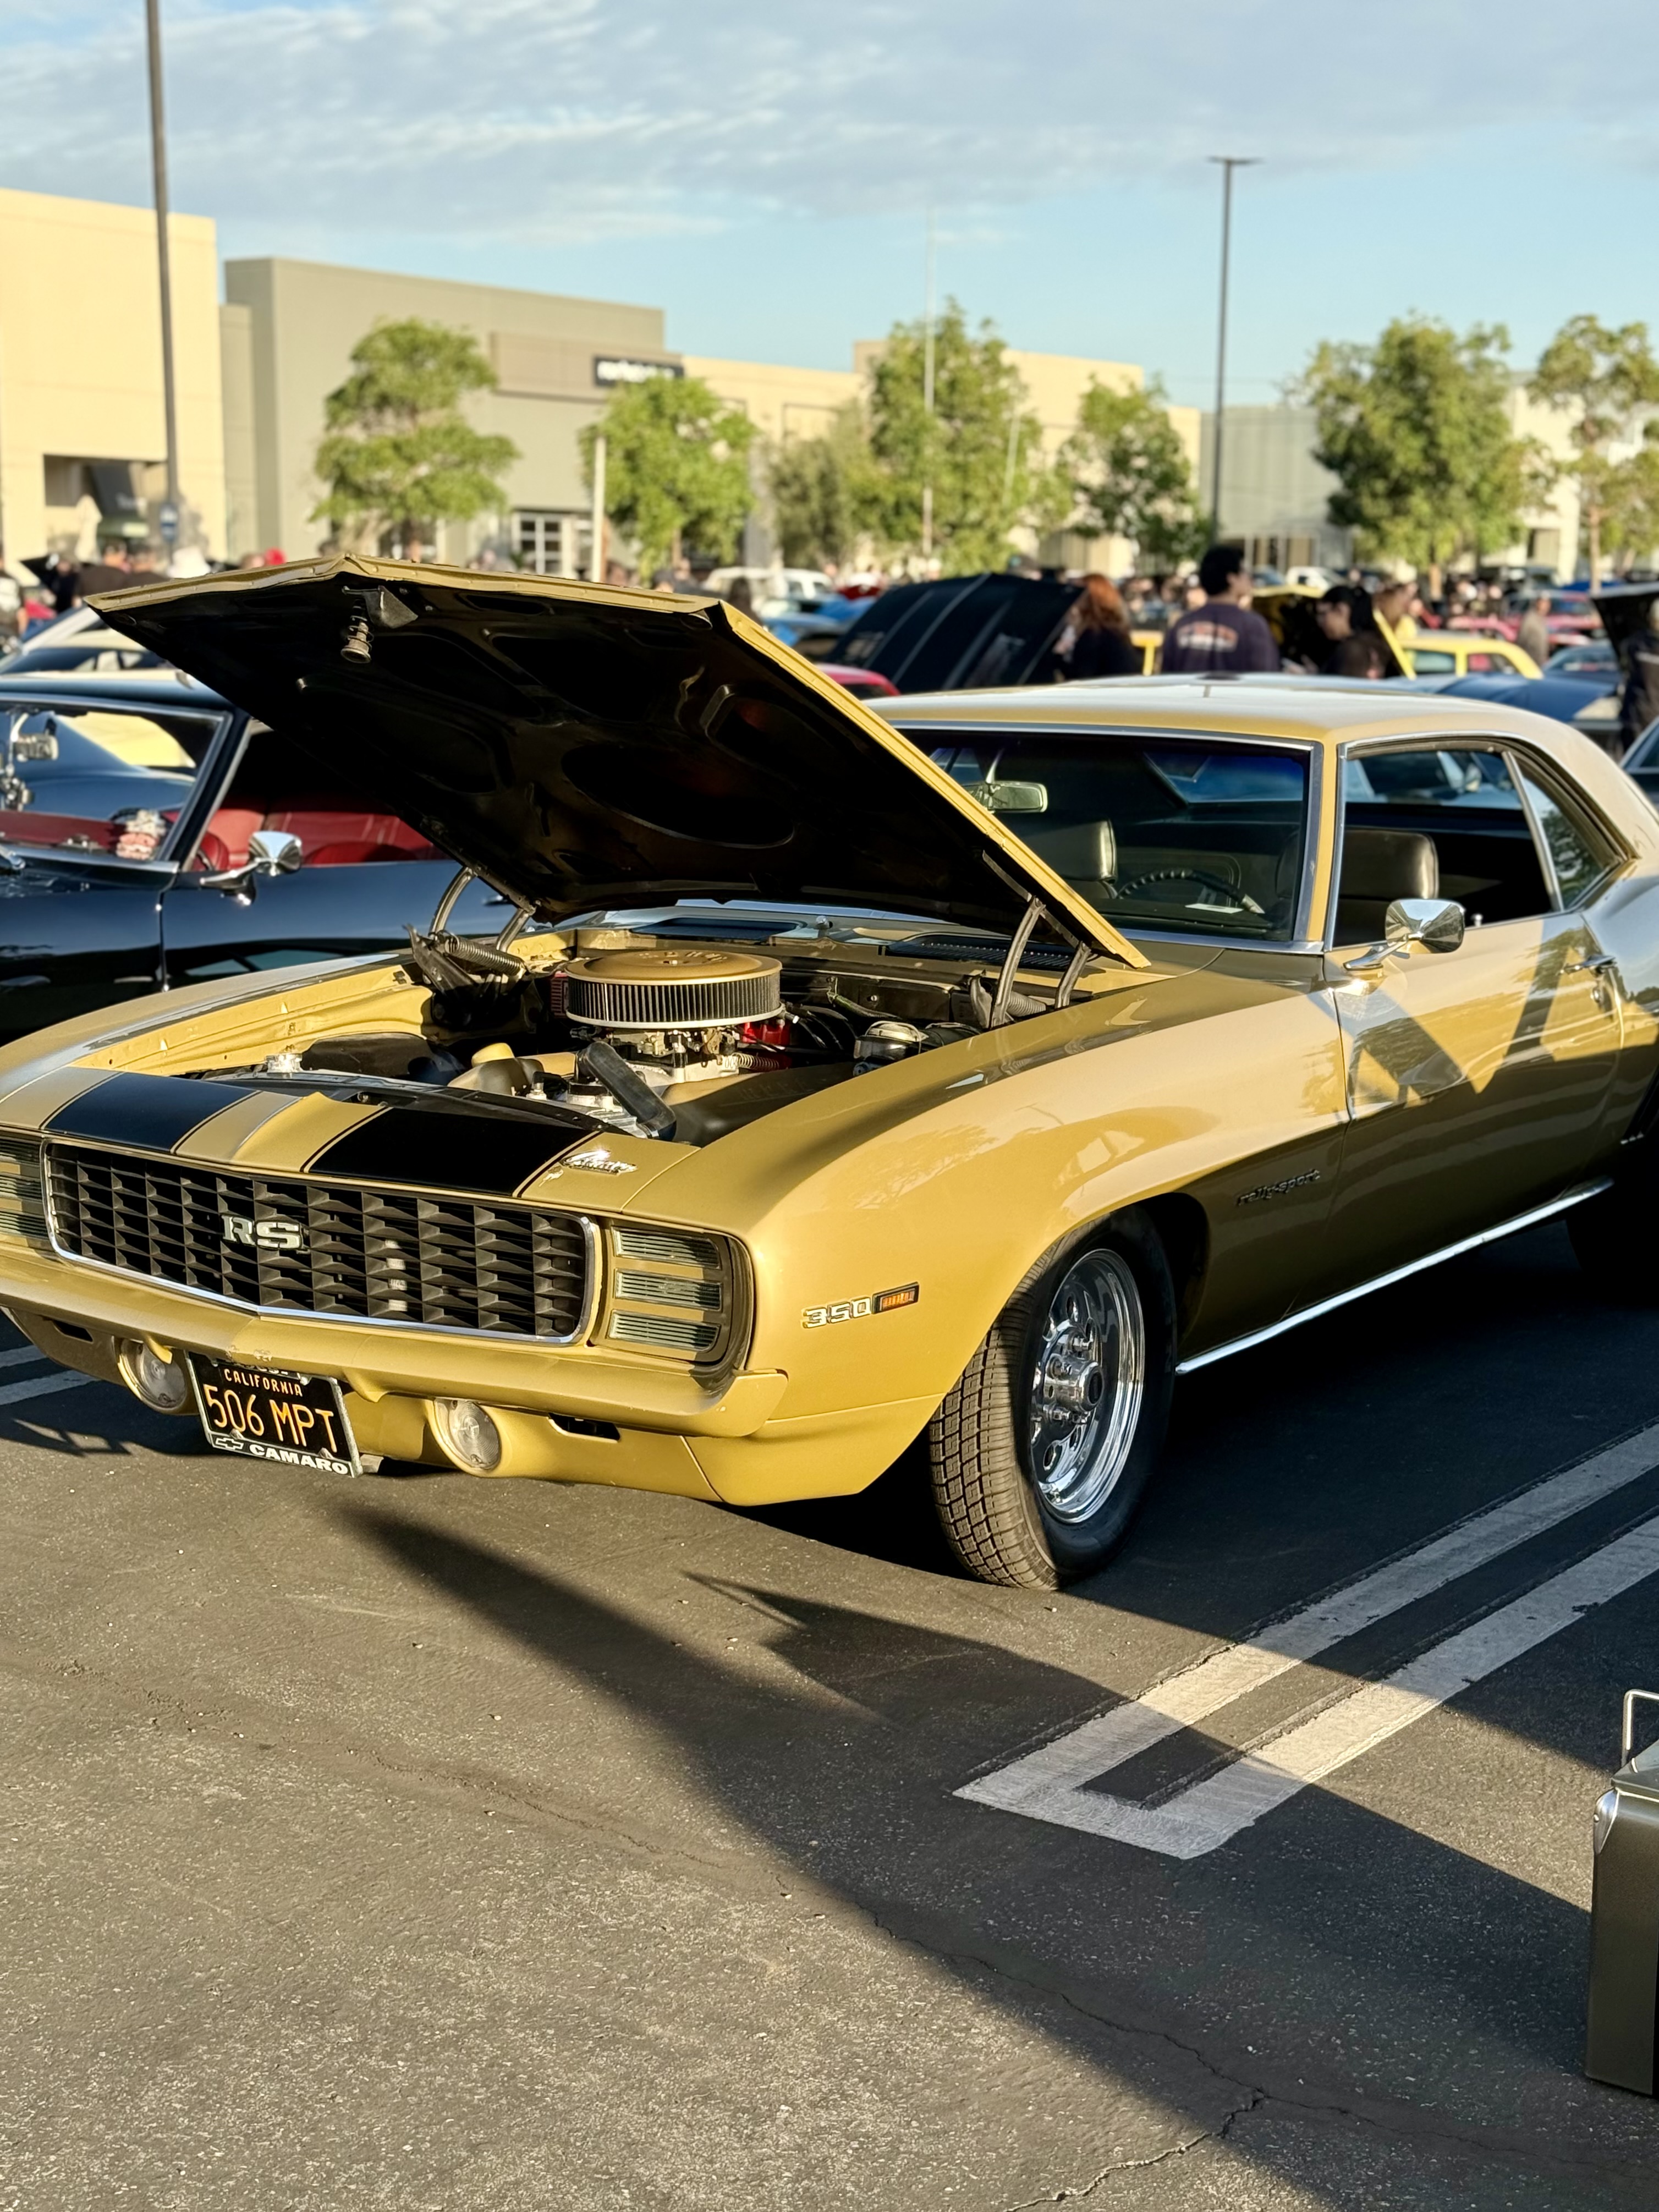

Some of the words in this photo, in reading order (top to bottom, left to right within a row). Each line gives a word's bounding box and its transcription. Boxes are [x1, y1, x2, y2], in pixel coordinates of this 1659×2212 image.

[221, 1215, 300, 1249] RS
[803, 1297, 872, 1329] 350
[224, 1368, 303, 1397] CALIFORNIA
[203, 1384, 265, 1436] 506
[269, 1399, 337, 1453] MPT
[249, 1445, 348, 1475] CAMARO
